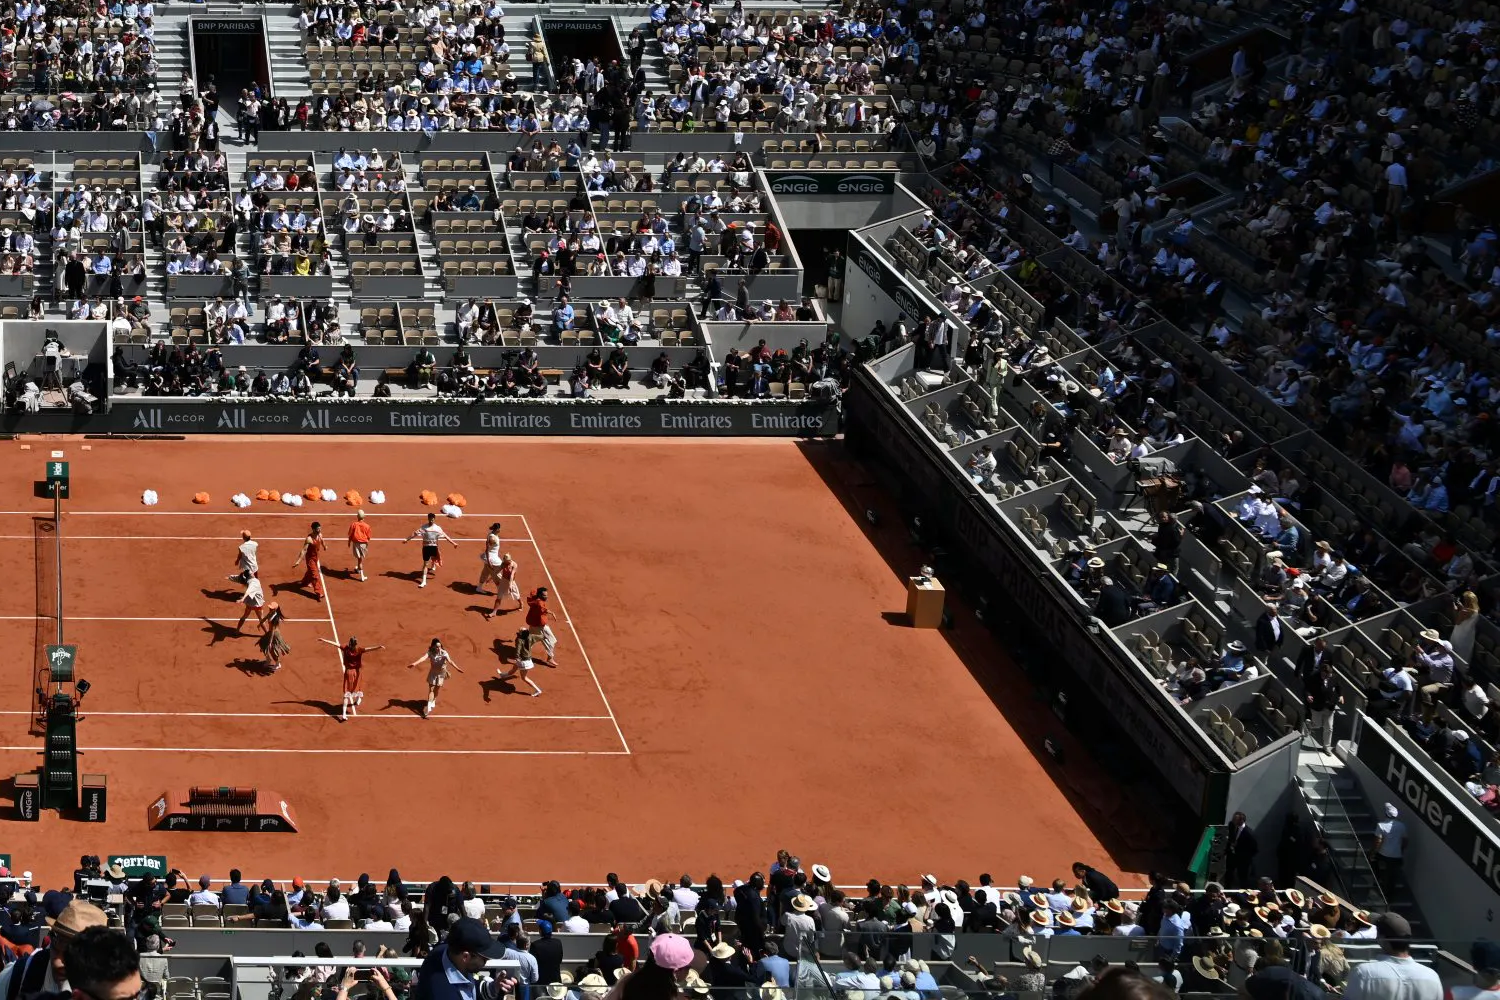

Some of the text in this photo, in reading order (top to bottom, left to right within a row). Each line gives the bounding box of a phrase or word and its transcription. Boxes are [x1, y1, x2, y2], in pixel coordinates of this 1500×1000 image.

[197, 22, 255, 30] BNP PARIBAS
[335, 415, 373, 423] ACCOR
[390, 411, 461, 427] Emirates
[480, 412, 551, 428] Emirates
[570, 412, 642, 428] Emirates
[660, 413, 732, 429] Emirates
[751, 413, 823, 429] Emirates
[1386, 753, 1453, 836] Haier
[89, 793, 98, 821] Wilson
